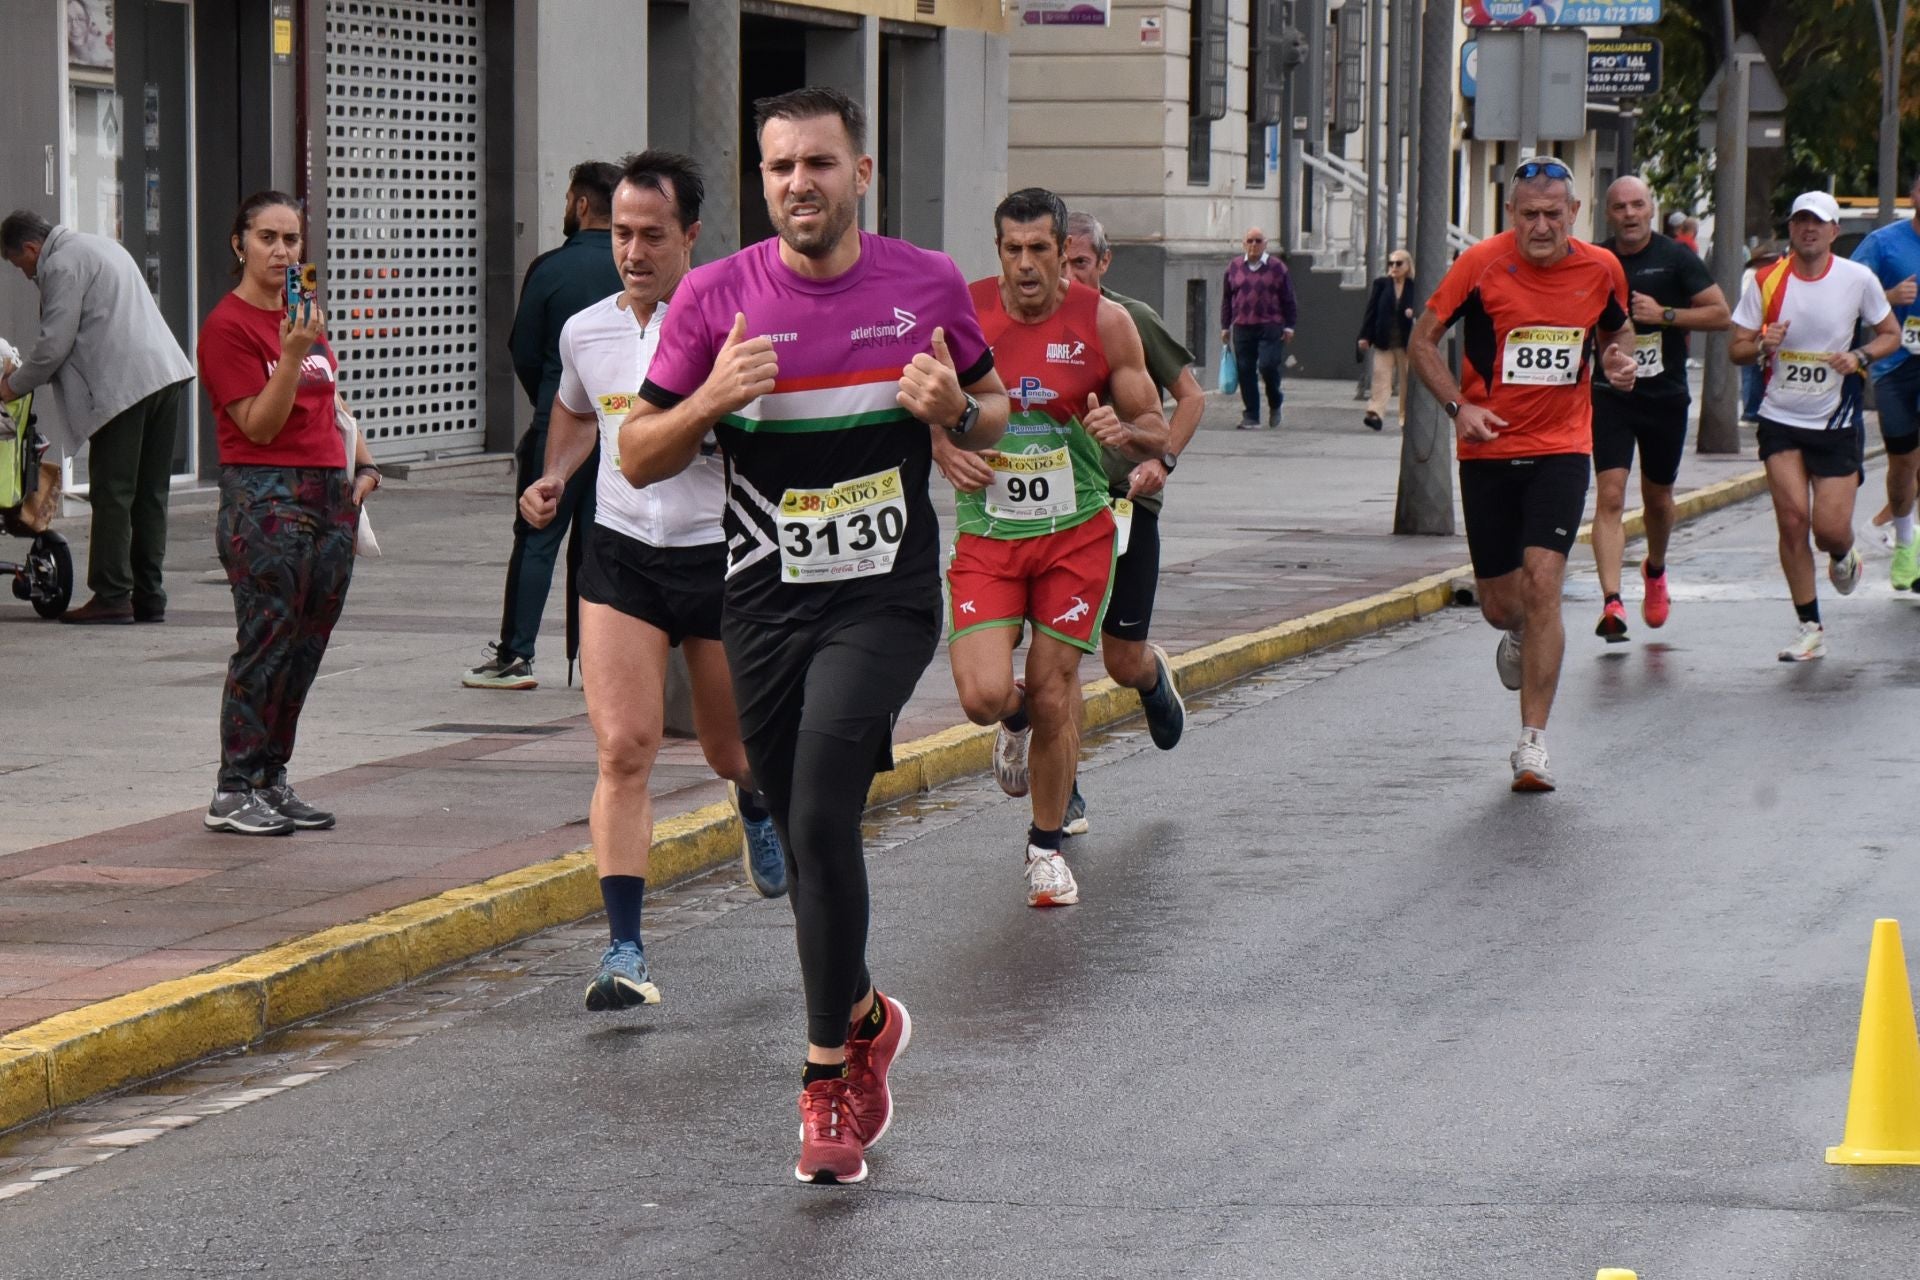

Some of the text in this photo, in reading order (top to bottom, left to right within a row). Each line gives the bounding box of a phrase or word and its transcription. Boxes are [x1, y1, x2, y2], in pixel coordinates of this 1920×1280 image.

[1490, 4, 1523, 15] VENTAS
[1577, 7, 1654, 21] 619 472 758
[1592, 74, 1610, 83] 619
[851, 325, 896, 340] atletismo
[852, 333, 919, 350] SANTA FE
[1046, 343, 1070, 360] ATARFE
[1516, 347, 1570, 369] 885
[1786, 365, 1827, 383] 290
[997, 456, 1009, 467] 38
[1009, 460, 1053, 471] FONDO
[1007, 477, 1050, 502] 90
[799, 495, 822, 511] 38
[783, 506, 904, 558] 3130
